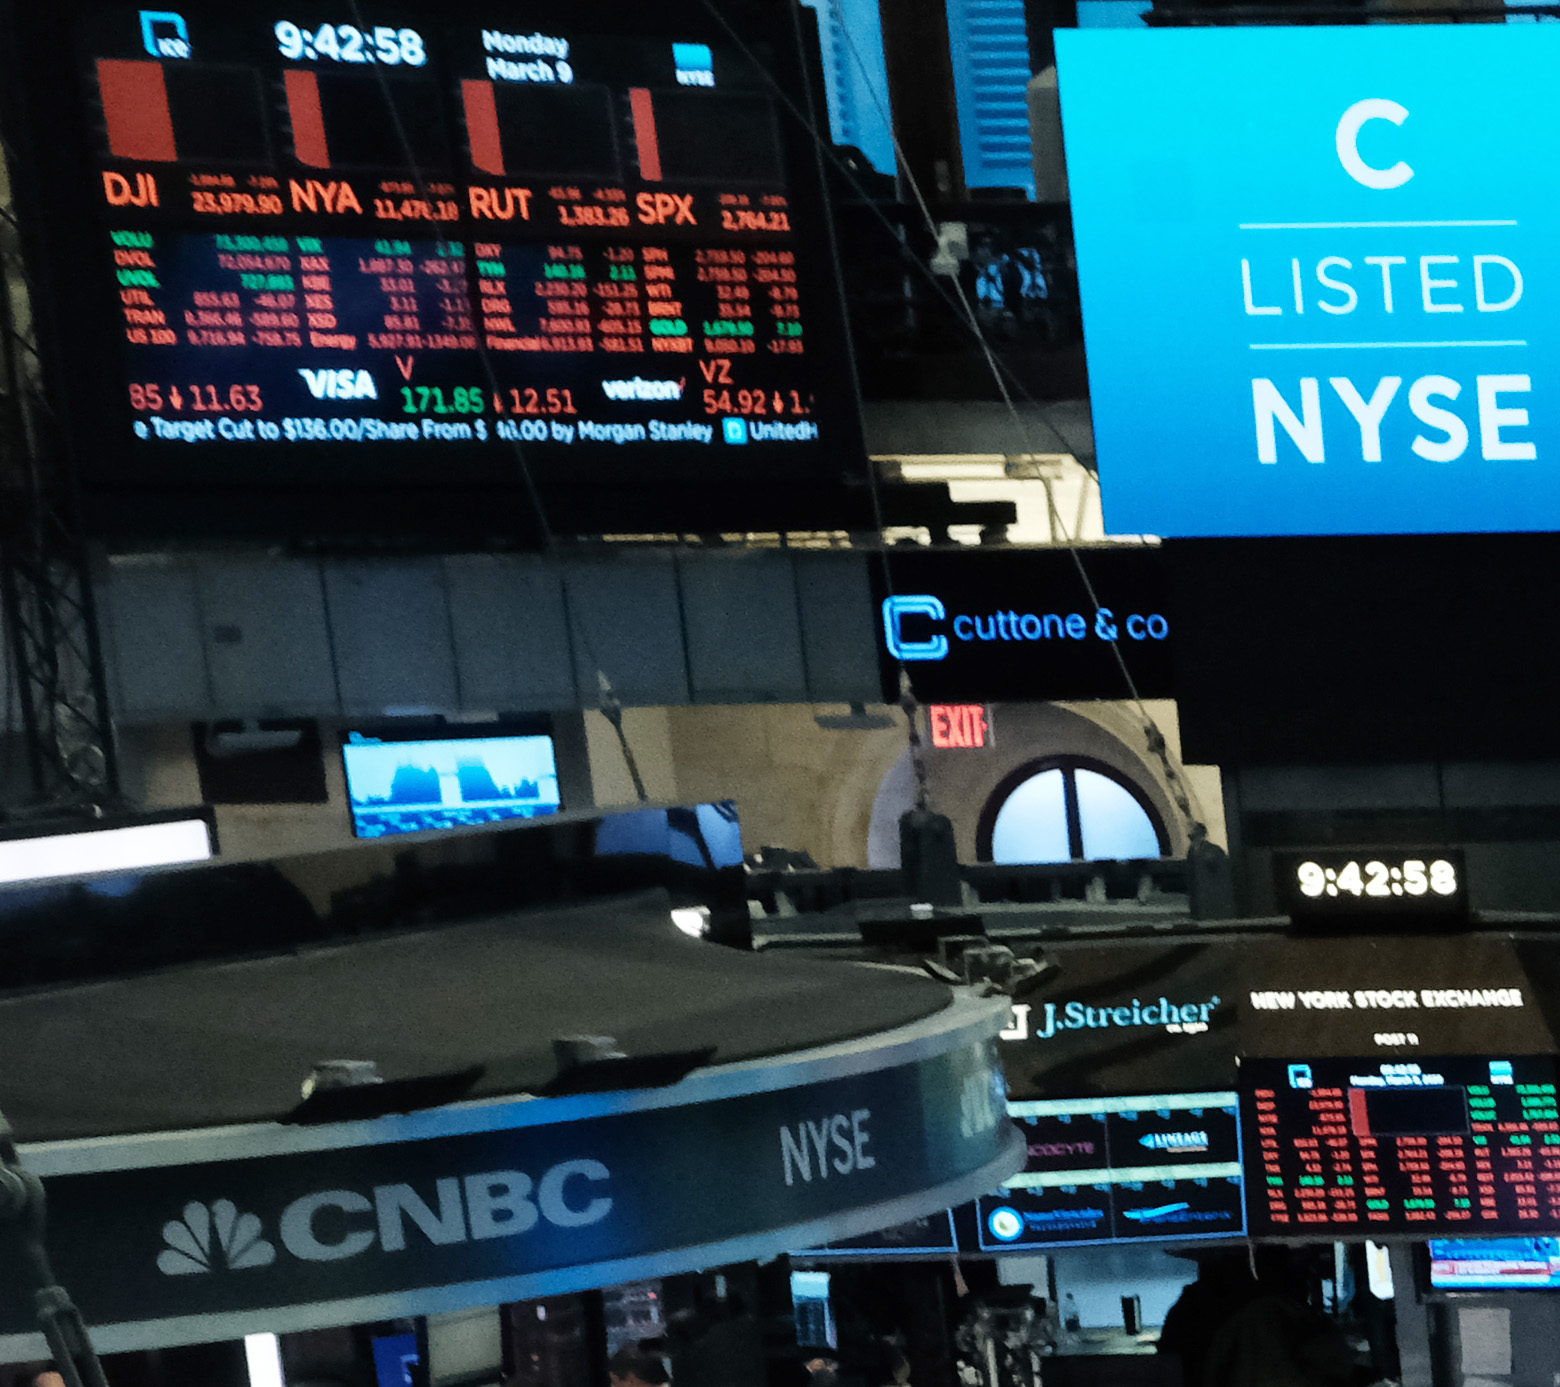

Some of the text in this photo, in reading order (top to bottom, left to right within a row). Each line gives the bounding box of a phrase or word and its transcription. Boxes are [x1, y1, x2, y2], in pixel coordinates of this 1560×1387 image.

[274, 19, 428, 67] 9:42:58
[481, 29, 570, 60] Monday
[486, 56, 574, 85] March 9
[1334, 98, 1414, 190] C
[102, 171, 160, 207] DJI
[289, 179, 364, 215] NYA
[469, 186, 533, 220] RUT
[636, 192, 698, 226] SPX
[1241, 254, 1524, 317] LISTED
[298, 368, 378, 400] VISA
[699, 359, 735, 385] VZ
[189, 384, 264, 412] 11.63
[401, 386, 485, 414] 171.85
[509, 388, 577, 414] 12.51
[703, 388, 767, 415] 54.92
[150, 416, 713, 445] Target Cut $136.00/Share From Morgan Stanley
[1251, 373, 1538, 465] NYSE
[953, 609, 1169, 643] cuttone & co
[930, 705, 986, 748] EXIT
[1297, 860, 1457, 899] 9:42:58
[1250, 988, 1524, 1010] NEW YORK STOCK EXCHANGE
[1038, 996, 1220, 1039] J.Streicher
[780, 1108, 873, 1187] NYSE
[279, 1158, 612, 1262] CNBC
